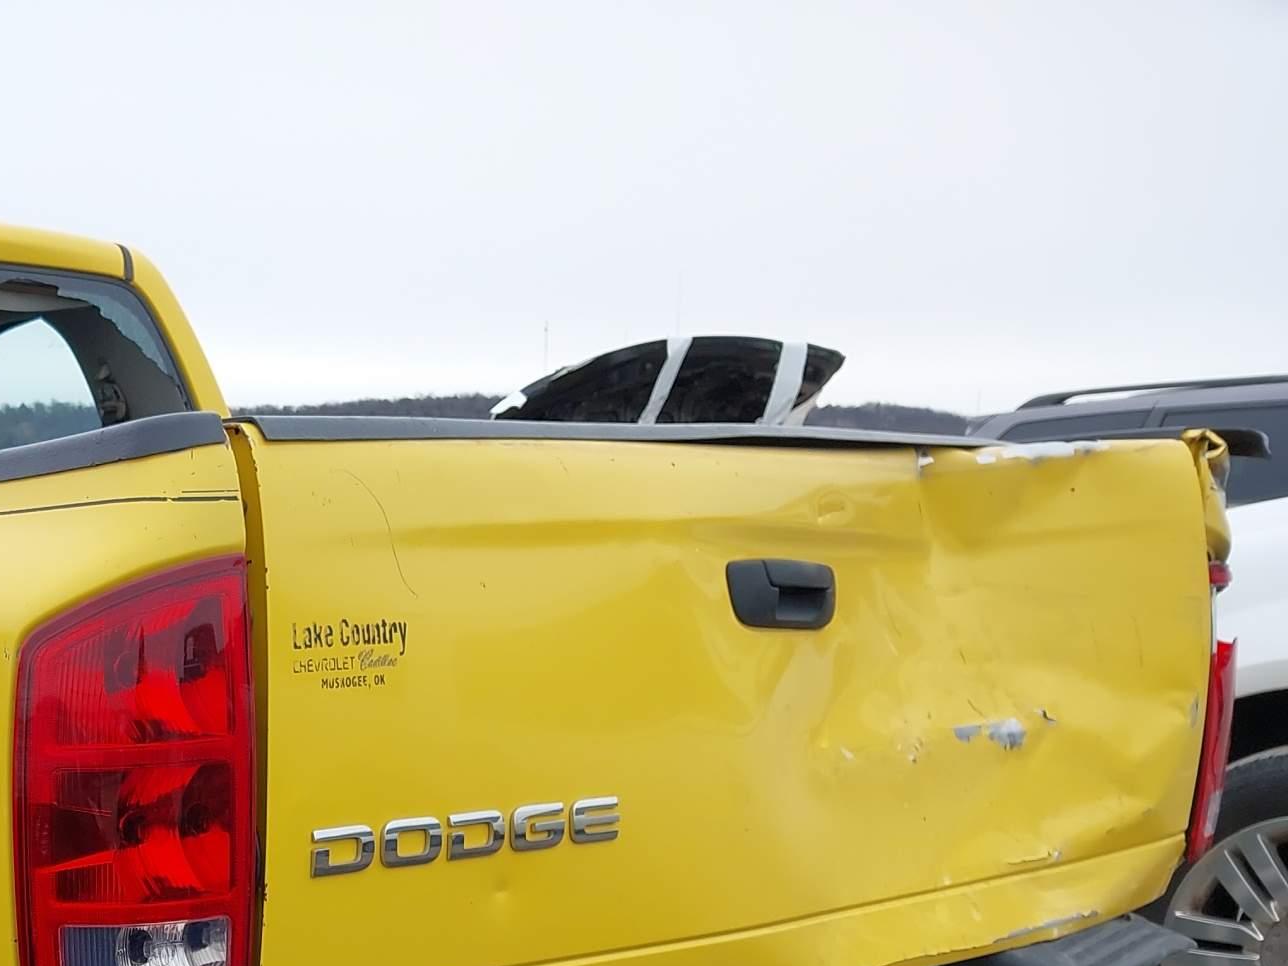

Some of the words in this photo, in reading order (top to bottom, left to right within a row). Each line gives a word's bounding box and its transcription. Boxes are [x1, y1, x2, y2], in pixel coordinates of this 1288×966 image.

[292, 622, 334, 650] Lake
[339, 618, 407, 656] Country
[293, 656, 355, 674] CHEVROLET
[373, 674, 386, 686] OK
[310, 796, 620, 879] DODGE
